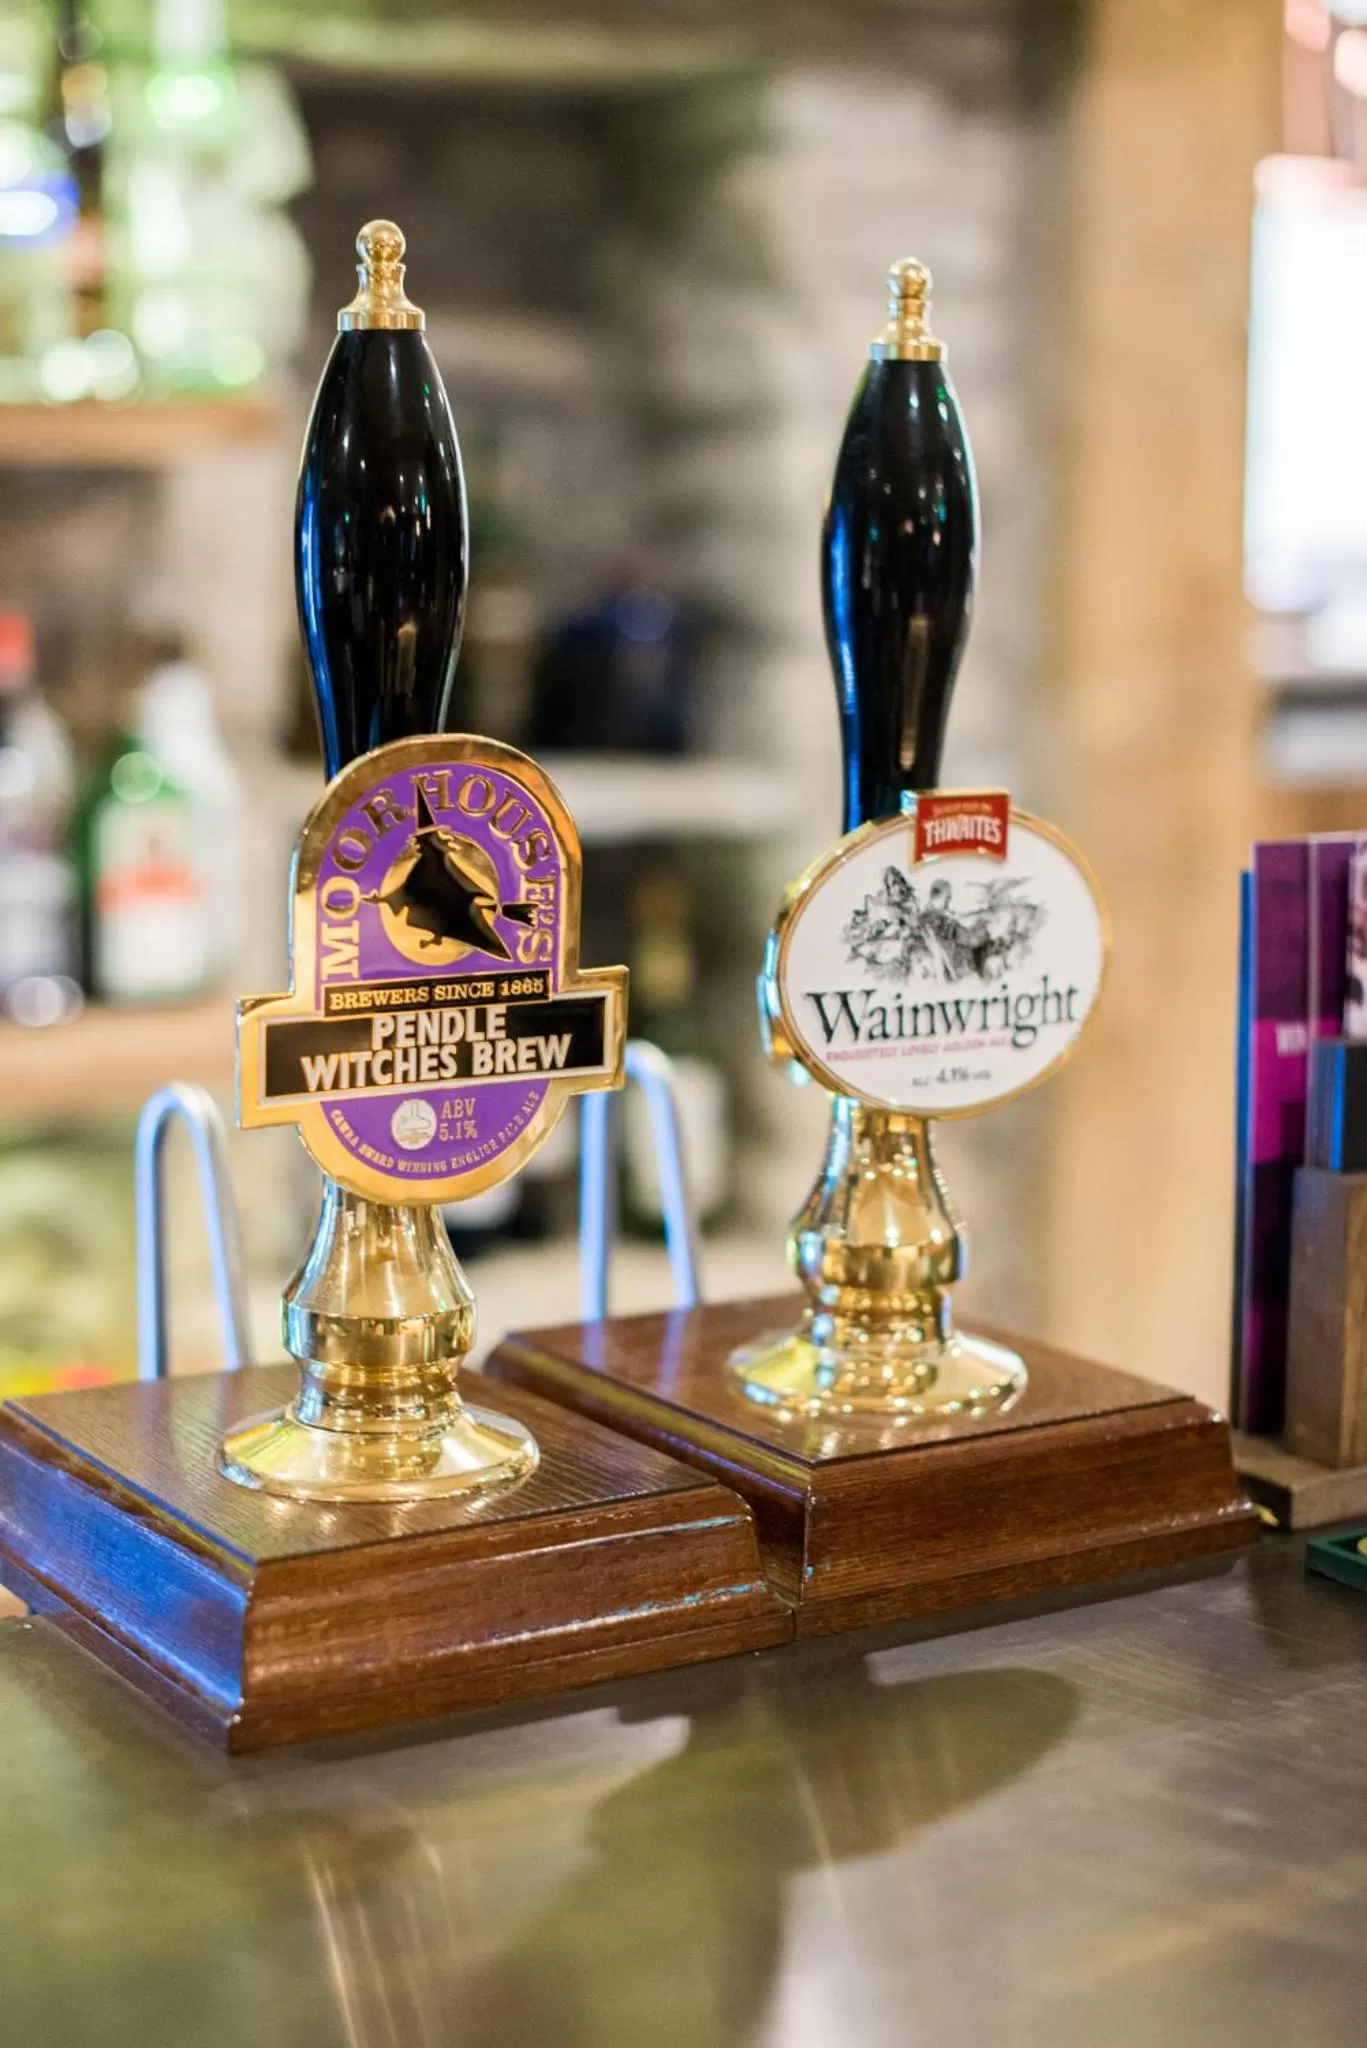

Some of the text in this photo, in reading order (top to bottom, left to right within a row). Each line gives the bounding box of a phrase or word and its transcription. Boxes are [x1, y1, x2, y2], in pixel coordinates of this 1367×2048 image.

[923, 814, 1002, 848] THWAITES
[330, 976, 545, 1010] BREWERS SINCE 1865
[805, 975, 1079, 1050] Wainwright
[371, 1005, 508, 1050] PENDLE
[301, 1033, 573, 1092] WITCHES BREW
[441, 1097, 477, 1119] ABV
[331, 1091, 540, 1175] CAMRA AWARD WINNING ENGLISH PALE ALE
[438, 1119, 478, 1142] 5.1%
